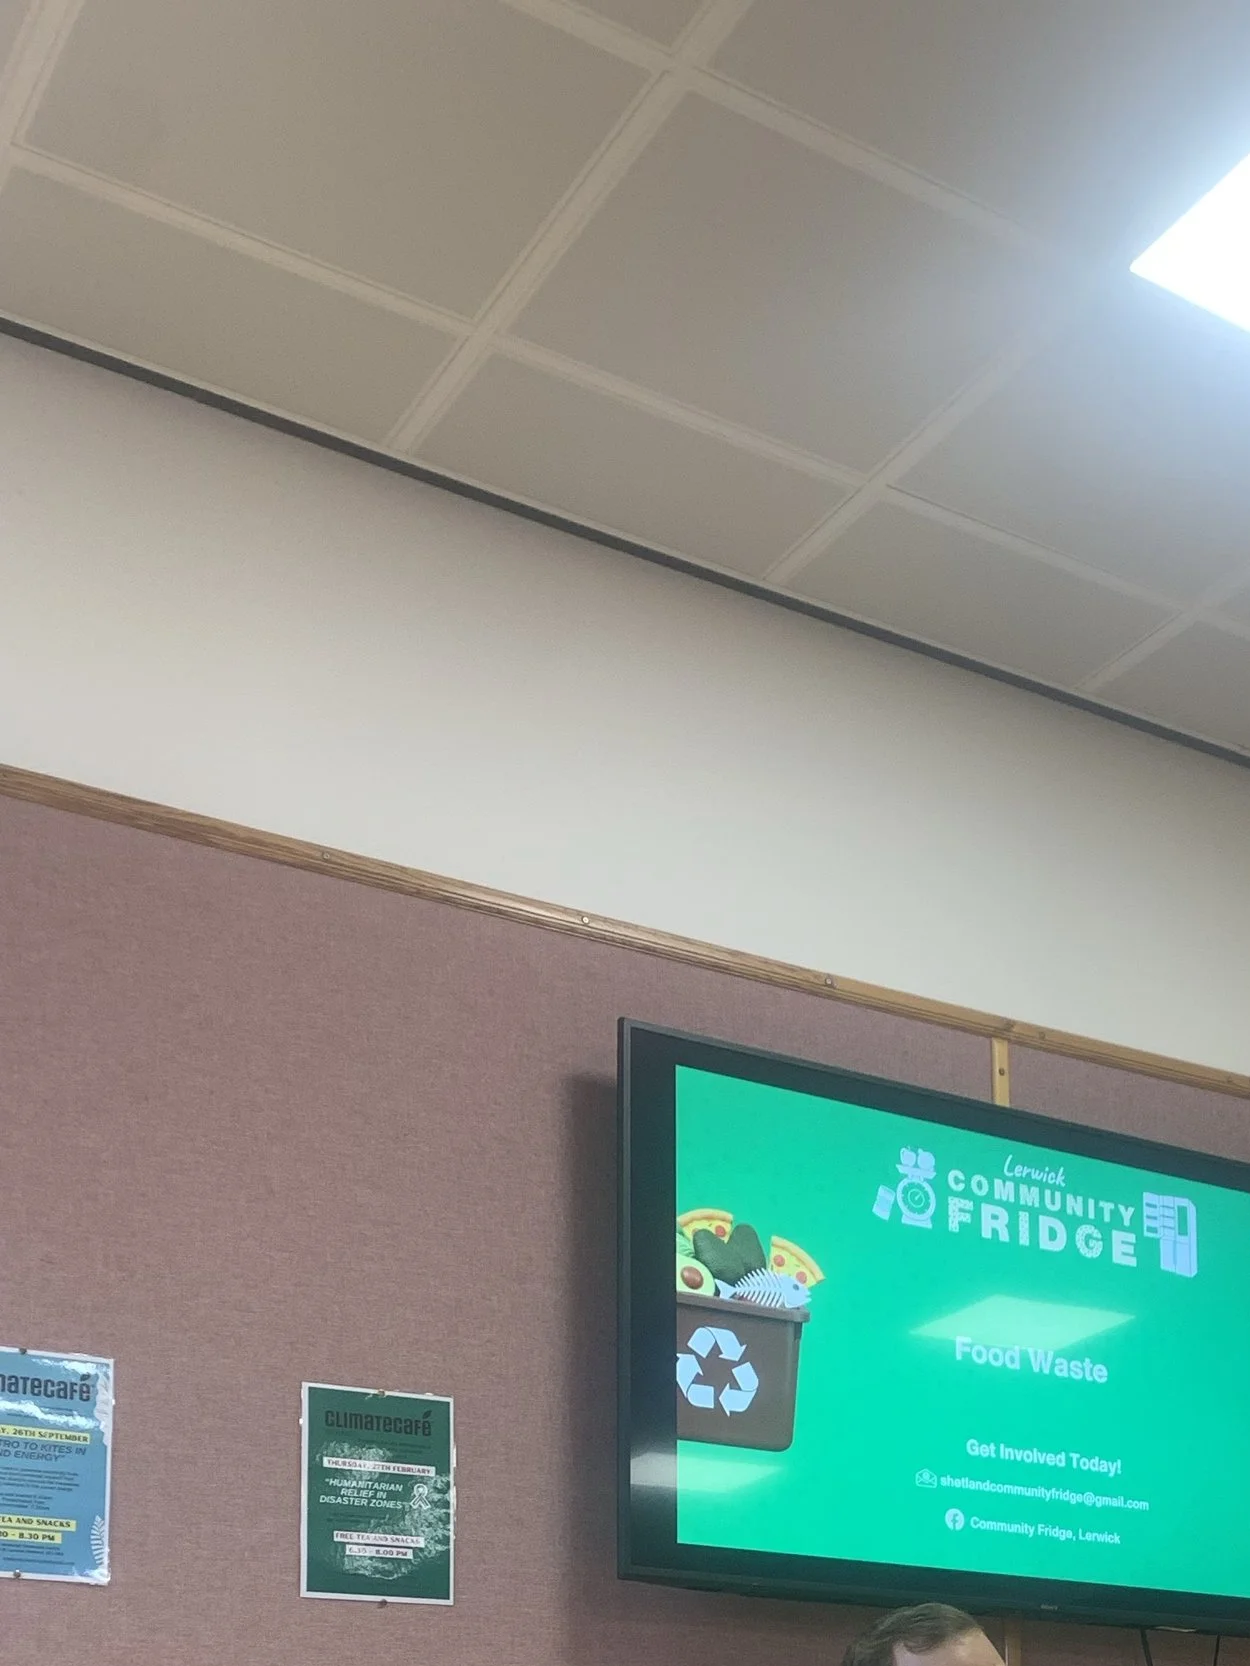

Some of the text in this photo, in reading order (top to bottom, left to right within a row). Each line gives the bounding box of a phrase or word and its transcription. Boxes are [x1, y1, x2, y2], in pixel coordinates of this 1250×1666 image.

[1003, 1154, 1066, 1187] Lerwick
[947, 1169, 1135, 1227] COMMUNITY
[948, 1196, 1137, 1267] FRIDGE
[955, 1336, 1108, 1383] Food Waste
[38, 1431, 88, 1442] SEPTEMBER
[23, 1441, 38, 1451] TO
[41, 1444, 72, 1455] KITES
[75, 1446, 87, 1456] IN
[966, 1438, 1121, 1478] Get Involved Today!
[392, 1465, 431, 1475] FEBRUARY
[319, 1495, 368, 1507] DISASTER
[340, 1487, 387, 1499] RELIEF IN
[940, 1475, 1149, 1511] shetlandcommunityfridge@gmail.com
[15, 1517, 33, 1525] AND
[36, 1519, 71, 1528] SNACKS
[970, 1516, 1035, 1538] Community
[1037, 1523, 1076, 1541] Fridge,
[1078, 1528, 1121, 1544] Lerwick
[335, 1532, 355, 1540] FREE
